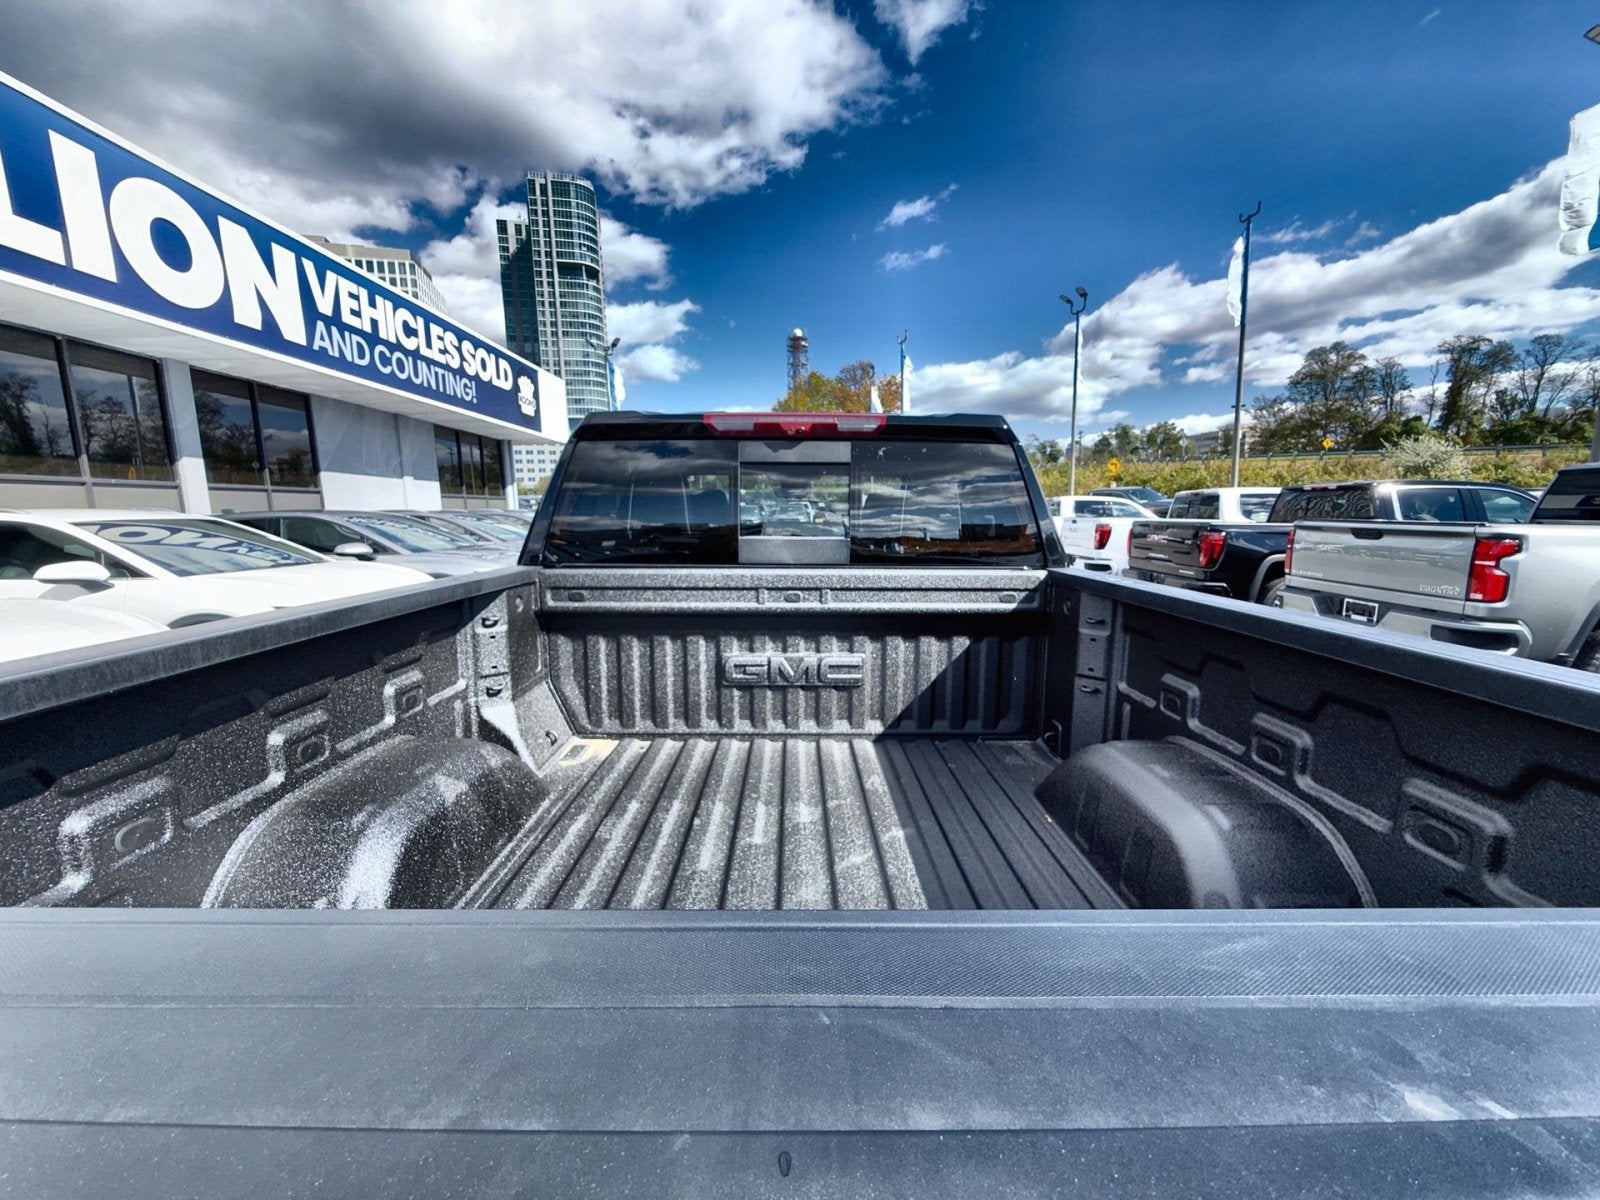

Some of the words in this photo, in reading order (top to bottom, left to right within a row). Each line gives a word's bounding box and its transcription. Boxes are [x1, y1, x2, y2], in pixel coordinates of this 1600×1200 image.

[301, 257, 461, 369] VEHICLES
[461, 340, 513, 391] SOLD
[313, 320, 370, 366] AND
[374, 345, 477, 403] COUNTING!
[724, 655, 864, 686] GMC
